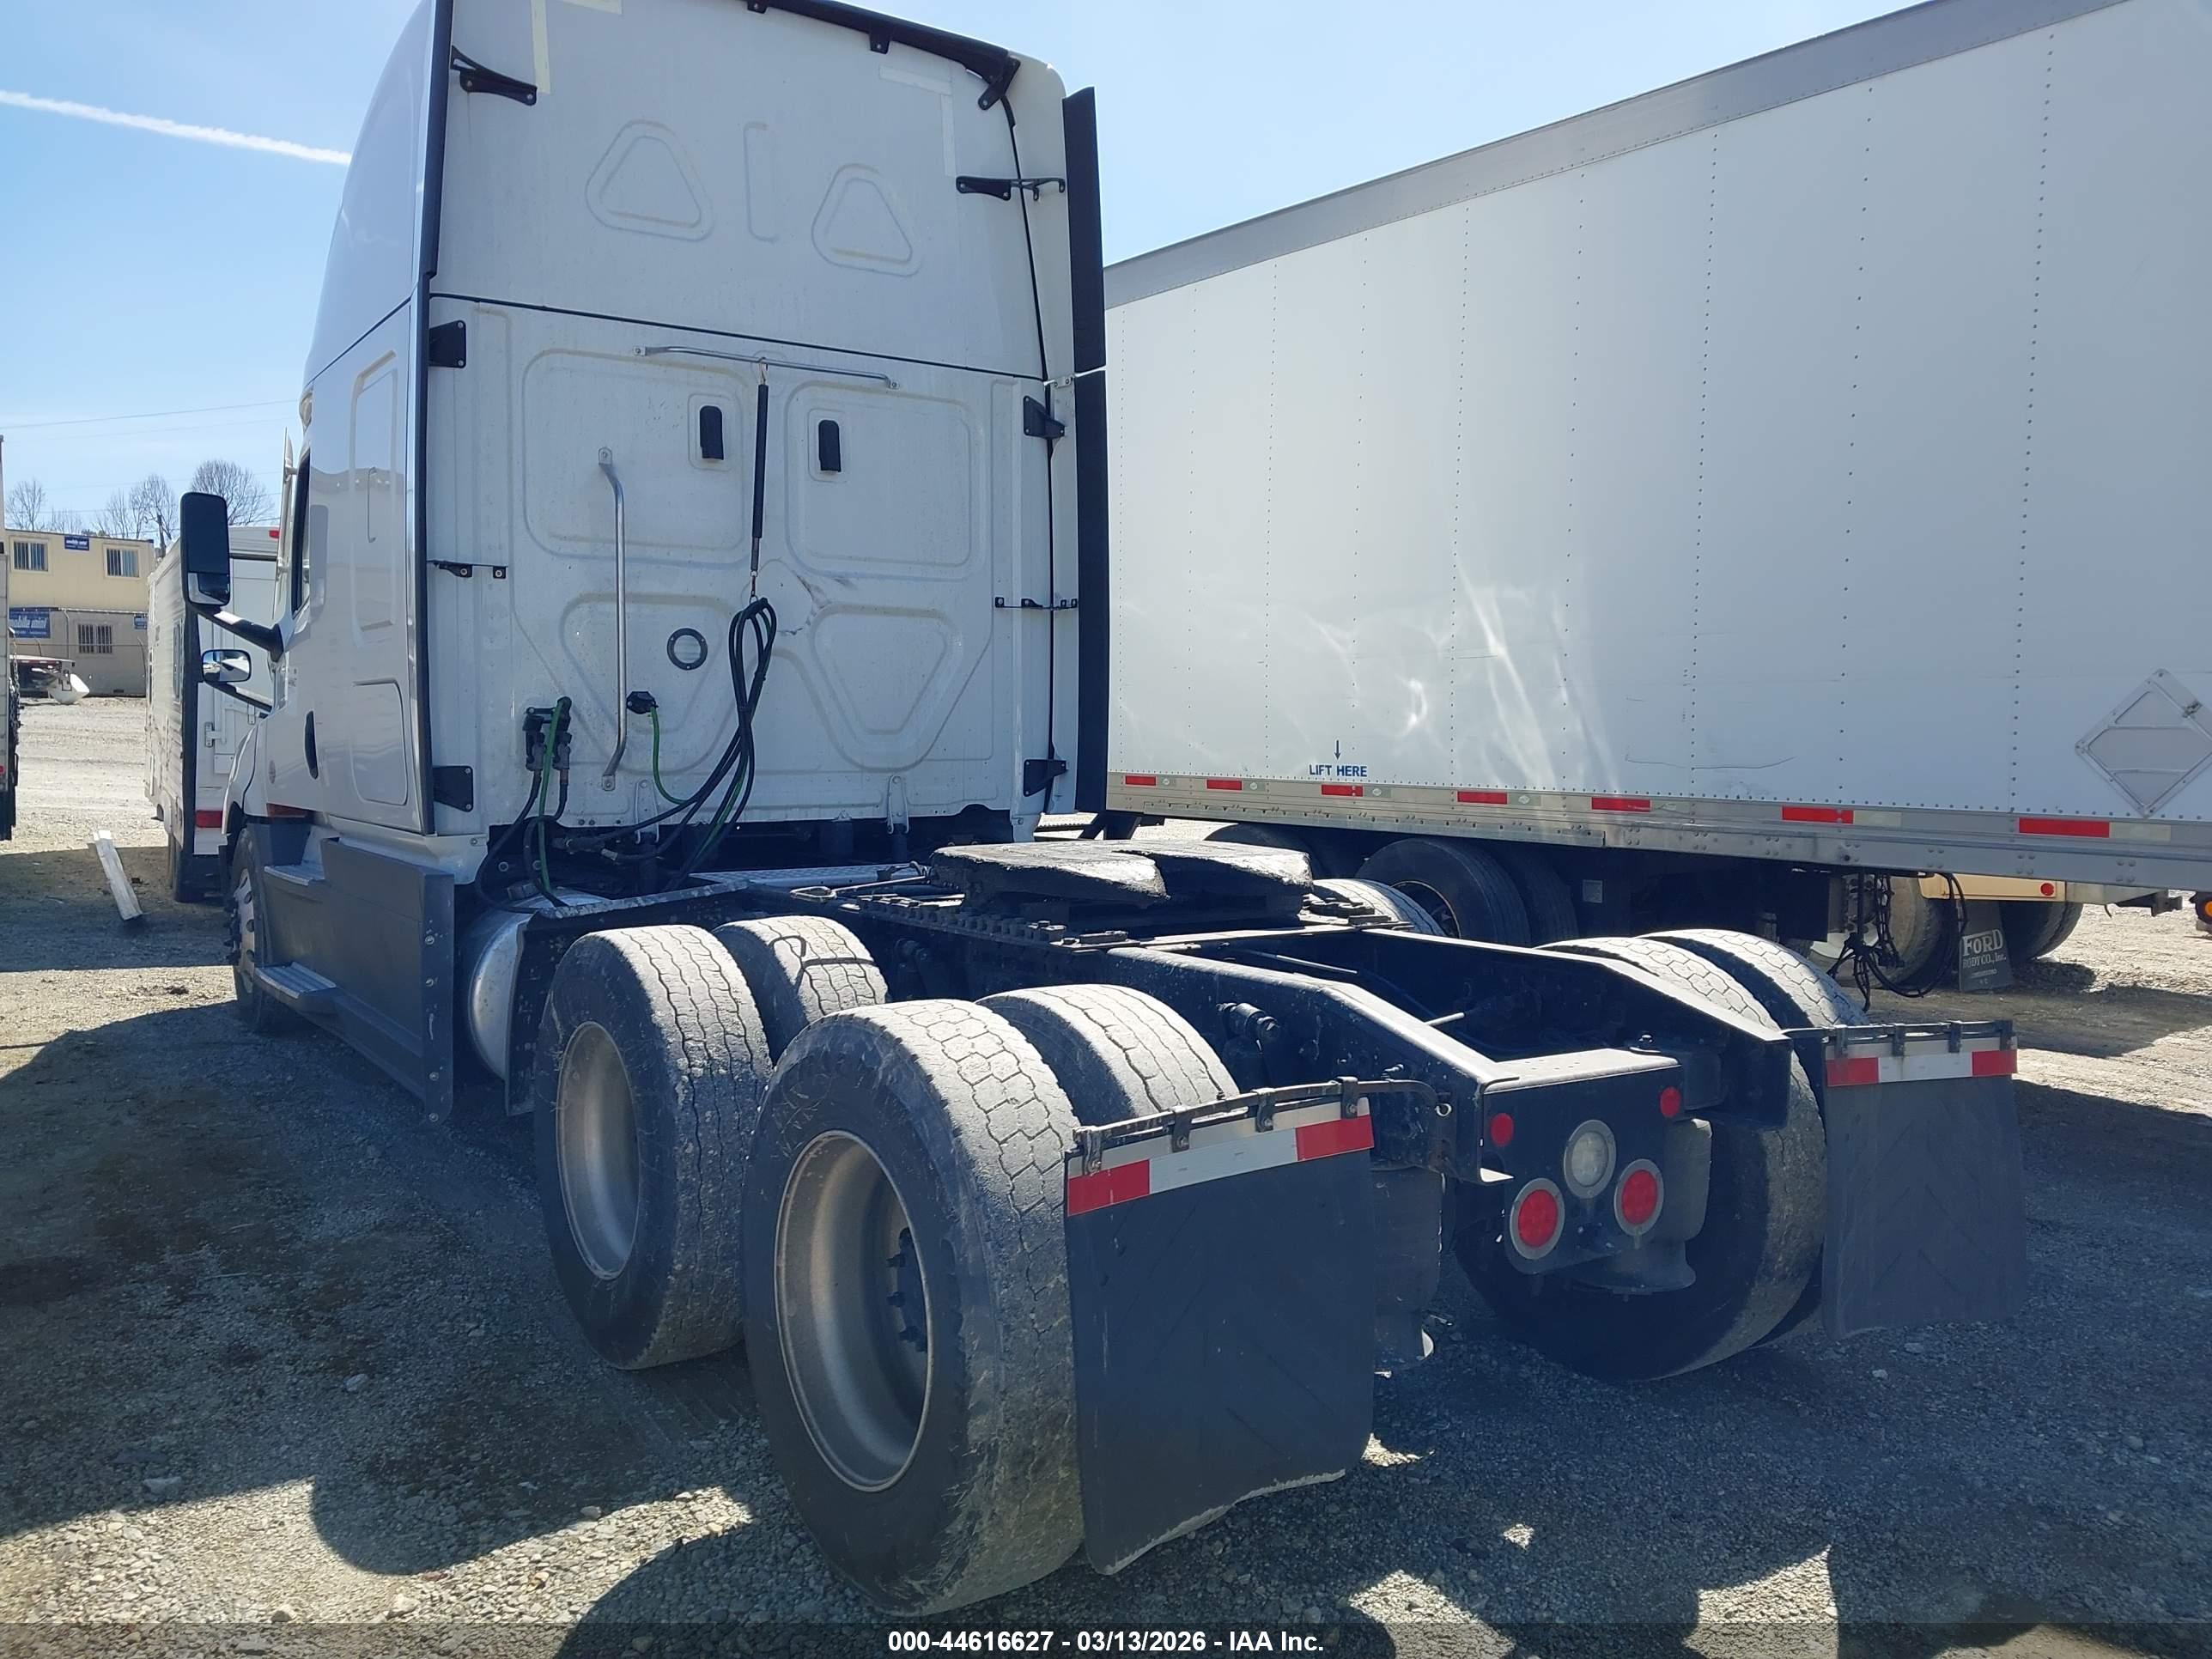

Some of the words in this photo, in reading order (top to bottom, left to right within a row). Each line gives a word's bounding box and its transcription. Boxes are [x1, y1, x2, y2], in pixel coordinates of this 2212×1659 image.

[1309, 764, 1332, 775] LIFT
[1336, 765, 1368, 777] HERE
[1961, 928, 2003, 957] FORD
